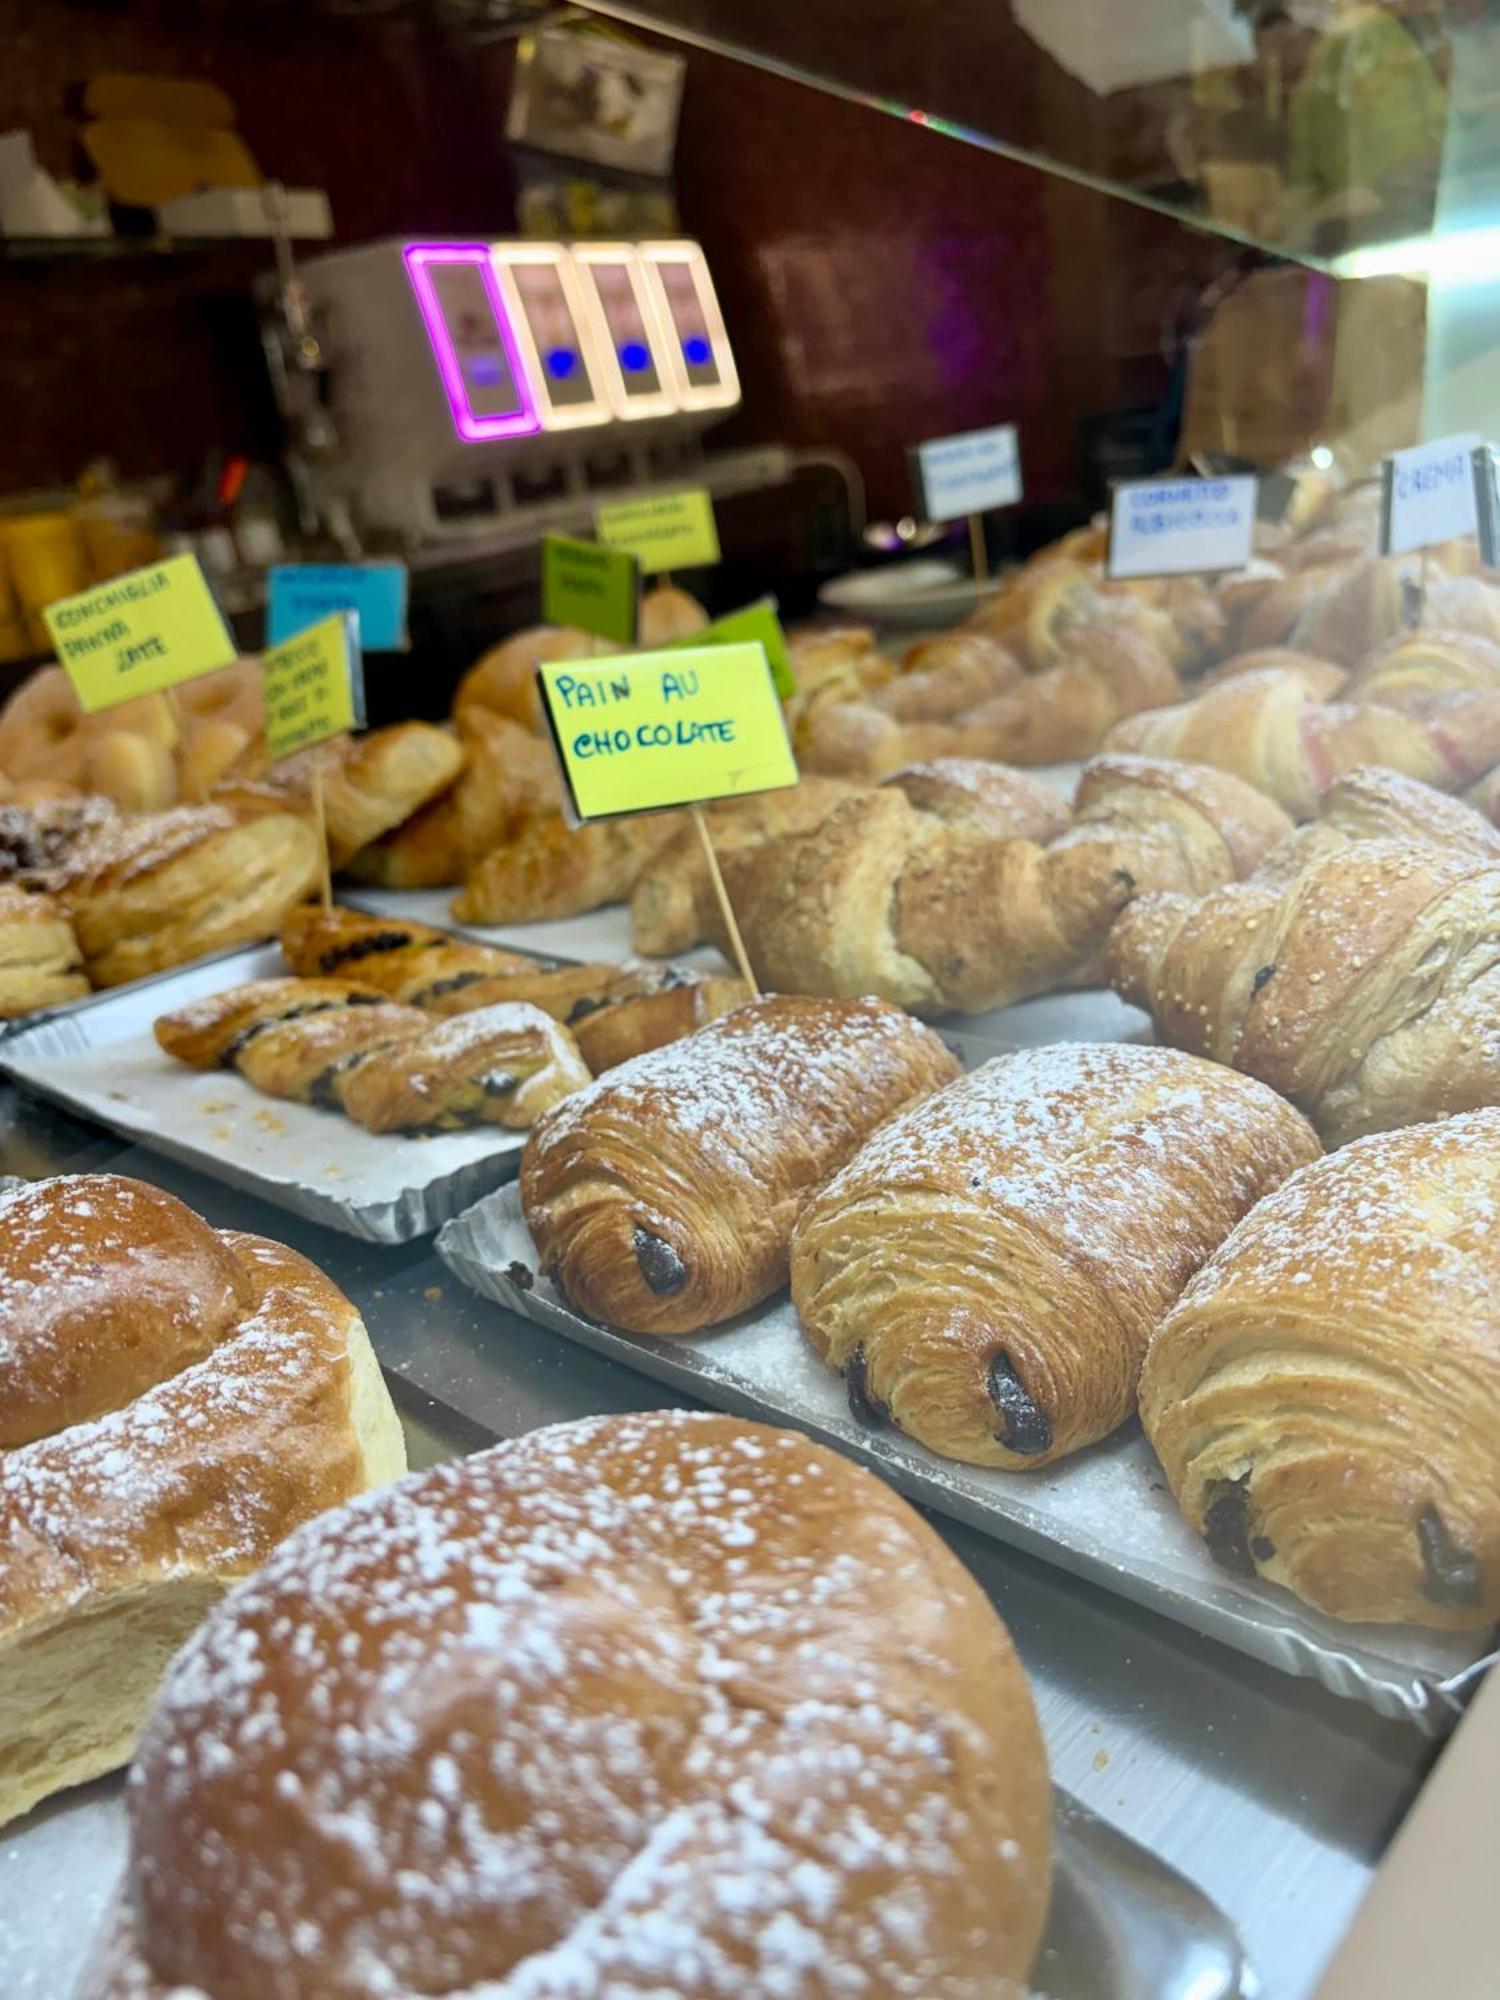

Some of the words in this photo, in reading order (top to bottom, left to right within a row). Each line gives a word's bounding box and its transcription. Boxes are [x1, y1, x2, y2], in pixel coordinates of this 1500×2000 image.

[1396, 455, 1464, 499] CREMA
[56, 571, 168, 629] CONCHIGLIA
[556, 674, 630, 708] PAIN
[662, 670, 700, 703] AU
[573, 719, 735, 758] CHOCOLATE
